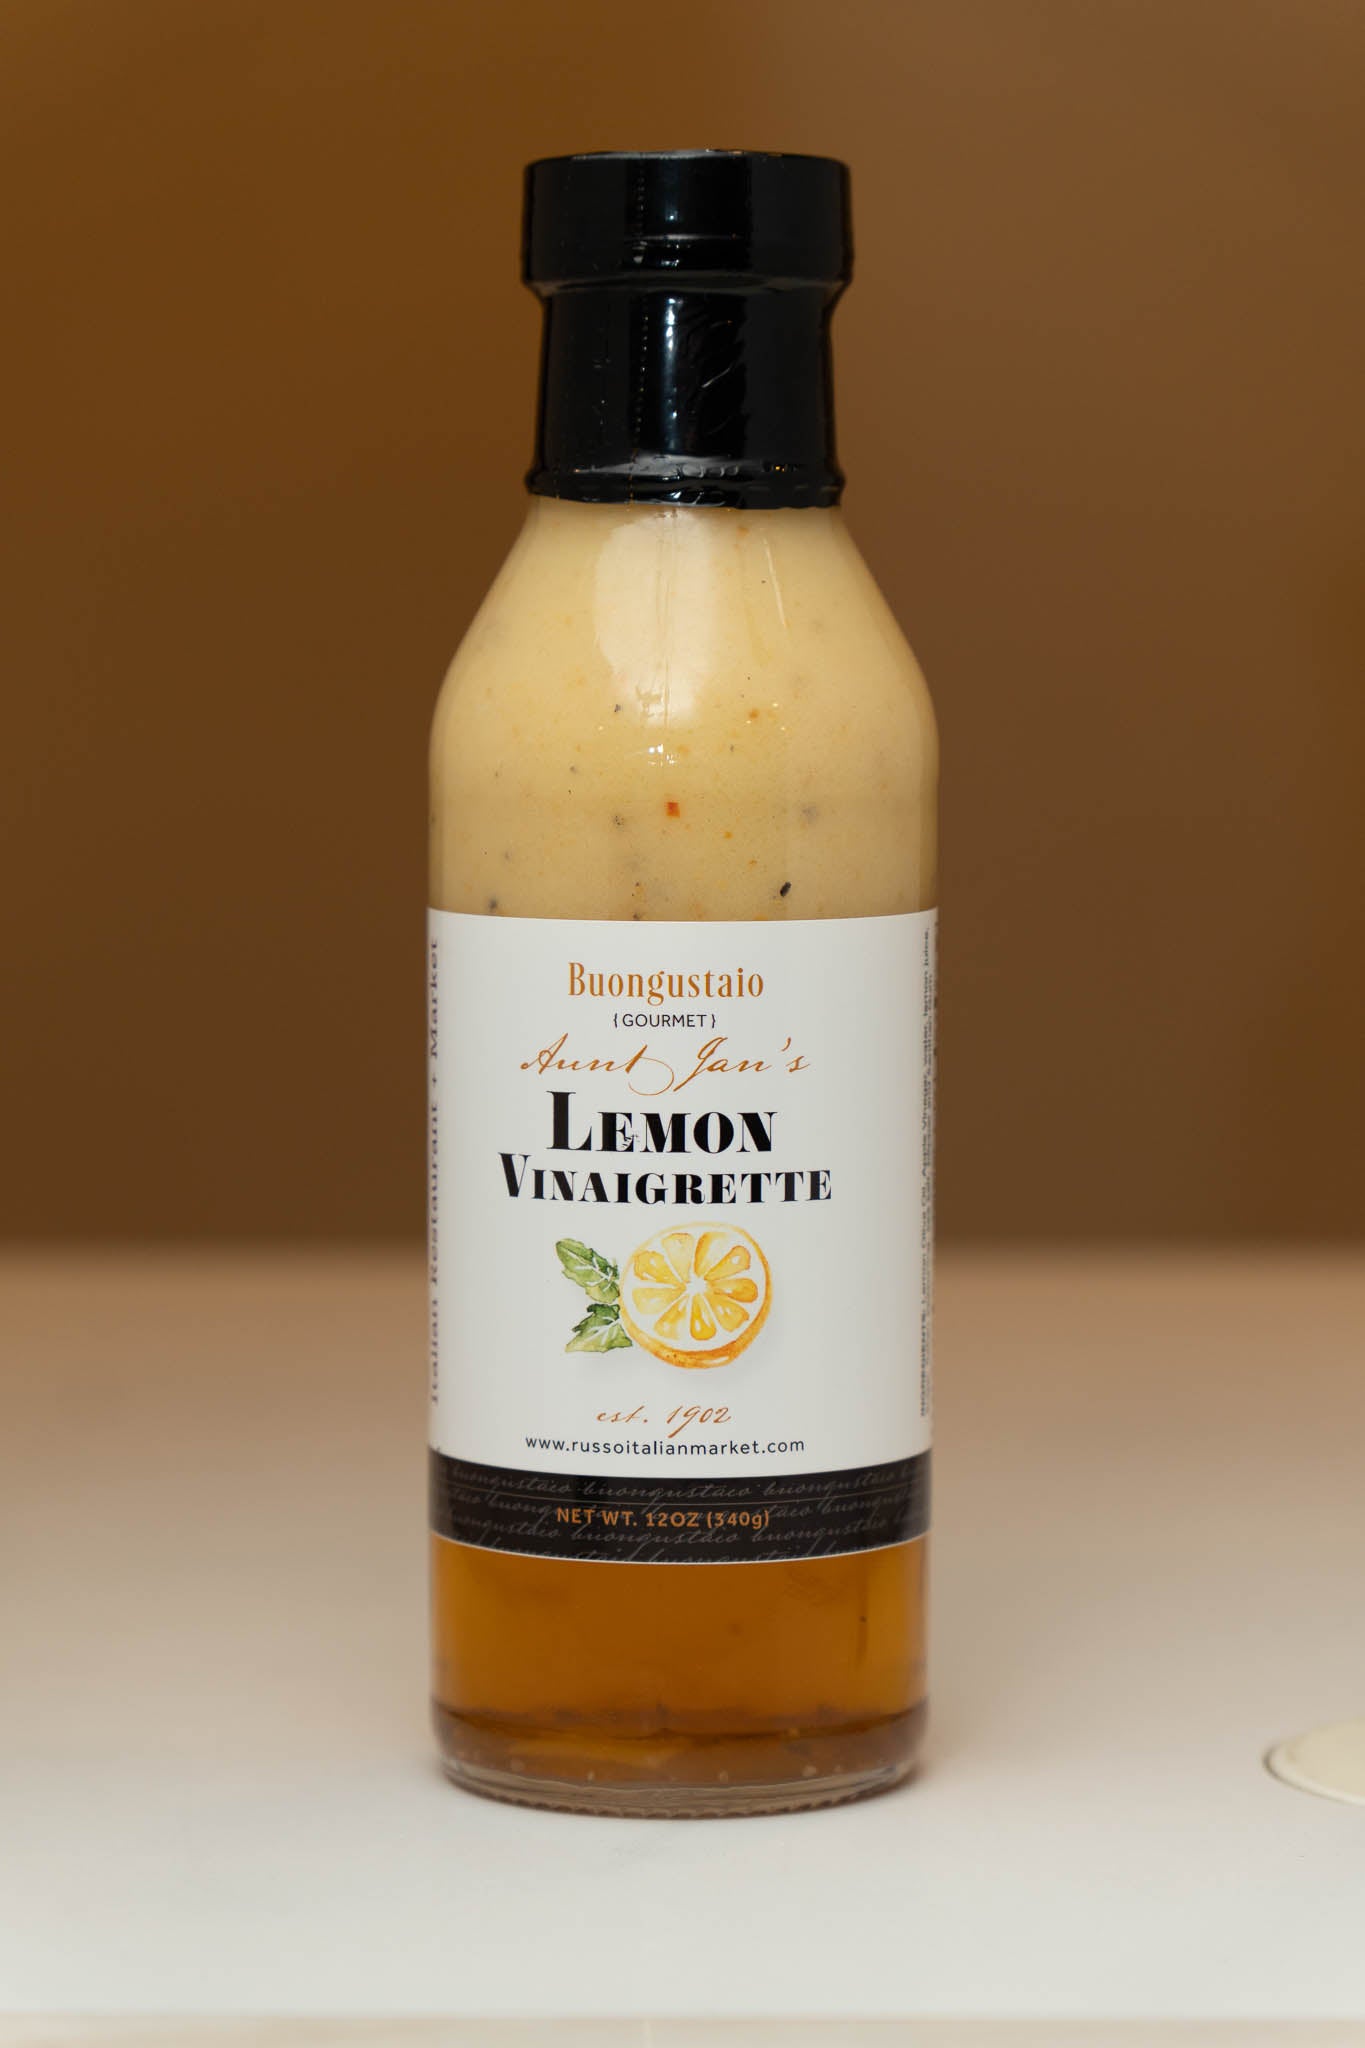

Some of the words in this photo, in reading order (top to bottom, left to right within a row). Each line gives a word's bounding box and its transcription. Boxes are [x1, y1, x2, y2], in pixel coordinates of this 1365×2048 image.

[428, 939, 439, 1059] Market
[567, 961, 764, 1007] Buongustaio
[520, 1032, 675, 1097] Aunt
[673, 1036, 811, 1092] Jan's
[428, 1103, 439, 1286] Restaurant
[596, 1405, 648, 1424] est.
[667, 1405, 732, 1439] 1902
[525, 1436, 805, 1456] www.russoitalianmarket.com
[556, 1507, 595, 1524] NET
[601, 1510, 637, 1526] WT.
[645, 1511, 700, 1528] 12OZ
[706, 1510, 770, 1530] (340g)
